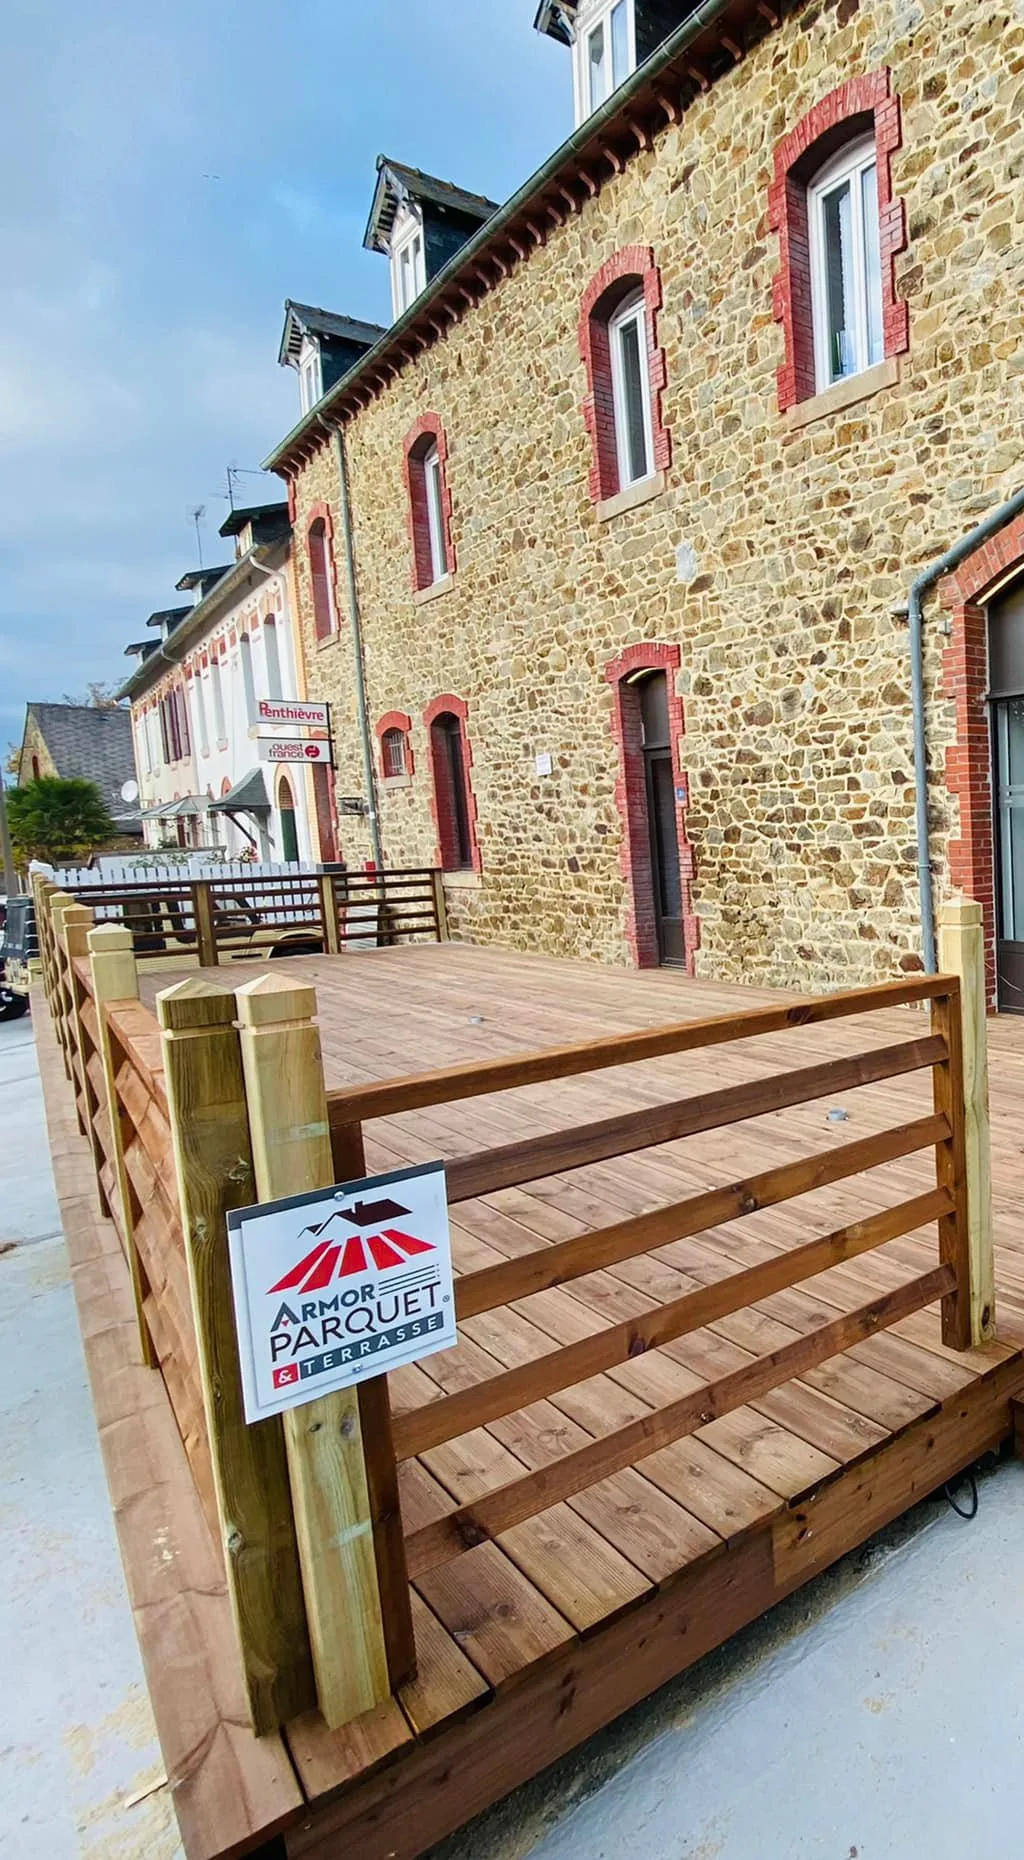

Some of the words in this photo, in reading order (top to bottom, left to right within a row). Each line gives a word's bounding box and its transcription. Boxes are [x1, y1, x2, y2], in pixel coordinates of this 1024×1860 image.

[259, 702, 324, 720] Penthièvre
[269, 749, 304, 758] france
[272, 743, 303, 751] ouest
[270, 1283, 376, 1333] ARMOR
[278, 1370, 292, 1384] &
[303, 1318, 438, 1375] TERRASSE
